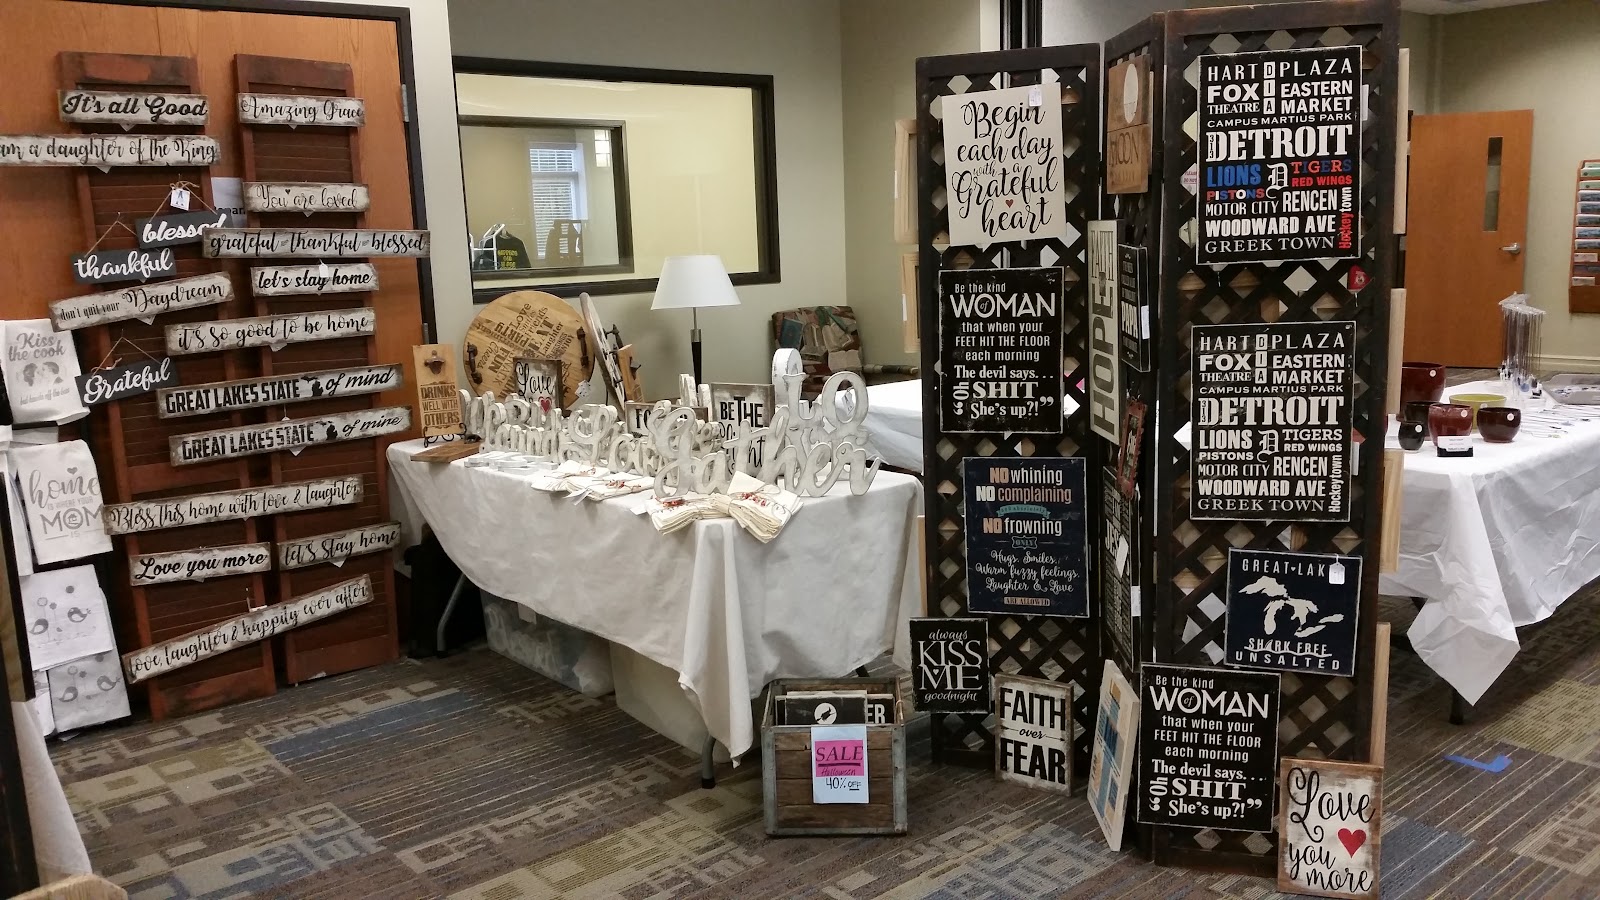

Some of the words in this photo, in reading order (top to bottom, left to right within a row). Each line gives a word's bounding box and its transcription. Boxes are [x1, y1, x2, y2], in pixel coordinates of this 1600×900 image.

[1207, 63, 1258, 82] HART
[1279, 58, 1353, 78] PLAZA
[1207, 83, 1260, 103] FOX
[1281, 80, 1353, 98] EASTERN
[62, 93, 105, 114] It's
[109, 97, 141, 114] all
[143, 96, 208, 122] Good
[241, 96, 319, 122] Amazing
[323, 99, 364, 120] Grace
[1207, 102, 1260, 114] THEATRE
[1281, 96, 1353, 114] MARKET
[960, 100, 1046, 139] Begin
[1207, 118, 1258, 128] CAMPUS
[1261, 115, 1315, 125] MARTIUS
[1319, 113, 1352, 122] PARK
[29, 144, 41, 157] a
[47, 137, 124, 165] daughter
[130, 138, 147, 164] of
[150, 138, 171, 160] the
[173, 137, 217, 163] King
[957, 127, 1008, 163] each
[1012, 126, 1054, 165] day
[1206, 124, 1353, 162] DETROIT
[973, 160, 996, 177] with
[1012, 162, 1022, 172] a
[1206, 164, 1261, 187] LIONS
[1290, 159, 1352, 174] TIGERS
[952, 156, 1058, 219] Grateful
[1291, 177, 1314, 187] RED
[1317, 175, 1353, 186] WINGS
[257, 185, 288, 208] You
[293, 194, 316, 206] are
[322, 189, 357, 208] loved
[1205, 202, 1247, 216] MOTOR
[1251, 200, 1279, 214] CITY
[1206, 187, 1265, 201] PISTONS
[1282, 189, 1337, 213] RENCEN
[981, 197, 1052, 237] heart
[1205, 216, 1300, 238] WOODWARD
[1304, 215, 1336, 234] AVE
[210, 231, 278, 257] grateful
[284, 231, 361, 256] thankful
[371, 232, 425, 253] blessed
[1205, 238, 1273, 253] GREEK
[1278, 235, 1335, 250] TOWN
[74, 248, 173, 279] thankful
[295, 270, 329, 290] stay
[332, 269, 372, 285] home
[955, 283, 965, 293] Be
[969, 283, 983, 292] the
[987, 283, 1006, 293] kind
[83, 303, 100, 319] quit
[122, 283, 224, 313] Daydream
[950, 293, 1056, 318] WOMAN
[509, 303, 532, 330] Love
[962, 322, 983, 332] that
[987, 322, 1015, 332] when
[1019, 322, 1043, 333] your
[1121, 301, 1138, 339] PAPA
[16, 332, 57, 350] Kiss
[236, 320, 278, 347] good
[277, 316, 299, 339] to
[304, 317, 322, 334] be
[327, 315, 368, 332] home
[527, 316, 554, 351] EAT
[538, 322, 564, 357] Laughter
[955, 337, 976, 347] FEET
[980, 336, 994, 346] HIT
[998, 336, 1015, 346] THE
[1020, 336, 1050, 346] FLOOR
[8, 346, 27, 362] the
[34, 340, 66, 359] cook
[488, 347, 511, 374] FUN
[965, 351, 990, 361] each
[994, 350, 1040, 361] morning
[1092, 283, 1115, 435] HOPE
[1272, 354, 1345, 369] EASTERN
[84, 357, 171, 404] Grateful
[515, 362, 555, 401] Love
[954, 365, 976, 378] The
[979, 365, 1006, 378] devil
[1199, 372, 1251, 382] THEATRE
[1272, 370, 1345, 384] MARKET
[166, 389, 211, 414] GREAT
[213, 384, 258, 407] LAKES
[261, 378, 300, 402] STATE
[325, 373, 344, 396] of
[345, 367, 394, 389] mind
[420, 385, 456, 399] DRINKS
[973, 381, 1038, 399] SHIT
[422, 401, 440, 411] WELL
[442, 400, 458, 410] WITH
[720, 402, 734, 420] BE
[734, 396, 763, 427] THE
[970, 401, 1006, 419] She's
[1198, 396, 1344, 426] DETROIT
[424, 411, 459, 426] OTHERS
[182, 436, 226, 460] GREAT
[230, 429, 274, 453] LAKES
[276, 424, 314, 444] STATE
[342, 420, 361, 437] of
[359, 415, 402, 431] mine
[1200, 429, 1252, 449] LIONS
[1282, 429, 1342, 441] TIGERS
[990, 467, 1009, 483] NO
[1010, 465, 1063, 486] whining
[1199, 452, 1254, 460] PISTONS
[1273, 457, 1328, 476] RENCEN
[29, 470, 101, 508] home
[976, 486, 995, 502] NO
[998, 486, 1072, 504] complaining
[1198, 480, 1290, 496] WOODWARD
[189, 503, 225, 519] home
[229, 493, 259, 516] with
[262, 492, 289, 511] love
[359, 530, 399, 547] home
[983, 518, 1003, 534] NO
[1004, 518, 1063, 537] frowning
[135, 557, 184, 580] Love
[187, 556, 220, 577] you
[223, 552, 267, 568] more
[975, 563, 1007, 575] Warm
[1010, 563, 1038, 580] fuzzy
[1242, 559, 1289, 574] GREAT
[986, 577, 1029, 594] Laughter
[1033, 579, 1048, 592] &
[1048, 580, 1074, 595] Love
[166, 625, 228, 666] laughter
[242, 608, 300, 639] happily
[928, 629, 968, 641] always
[917, 640, 983, 667] KISS
[1297, 642, 1327, 655] FREE
[1236, 651, 1340, 670] UNSALTED
[918, 665, 983, 690] ME
[924, 691, 977, 704] goodnight
[1000, 687, 1066, 731] FAITH
[1150, 686, 1269, 719] WOMAN
[1019, 725, 1045, 739] over
[1227, 735, 1262, 748] FLOOR
[816, 746, 863, 762] SALE
[1000, 738, 1066, 784] FEAR
[1198, 748, 1249, 763] morning
[821, 768, 856, 776] Halloween
[1180, 762, 1211, 777] devil
[826, 777, 846, 789] 40%
[1287, 767, 1376, 843] Love
[1289, 843, 1336, 880] you
[1306, 867, 1373, 893] more
